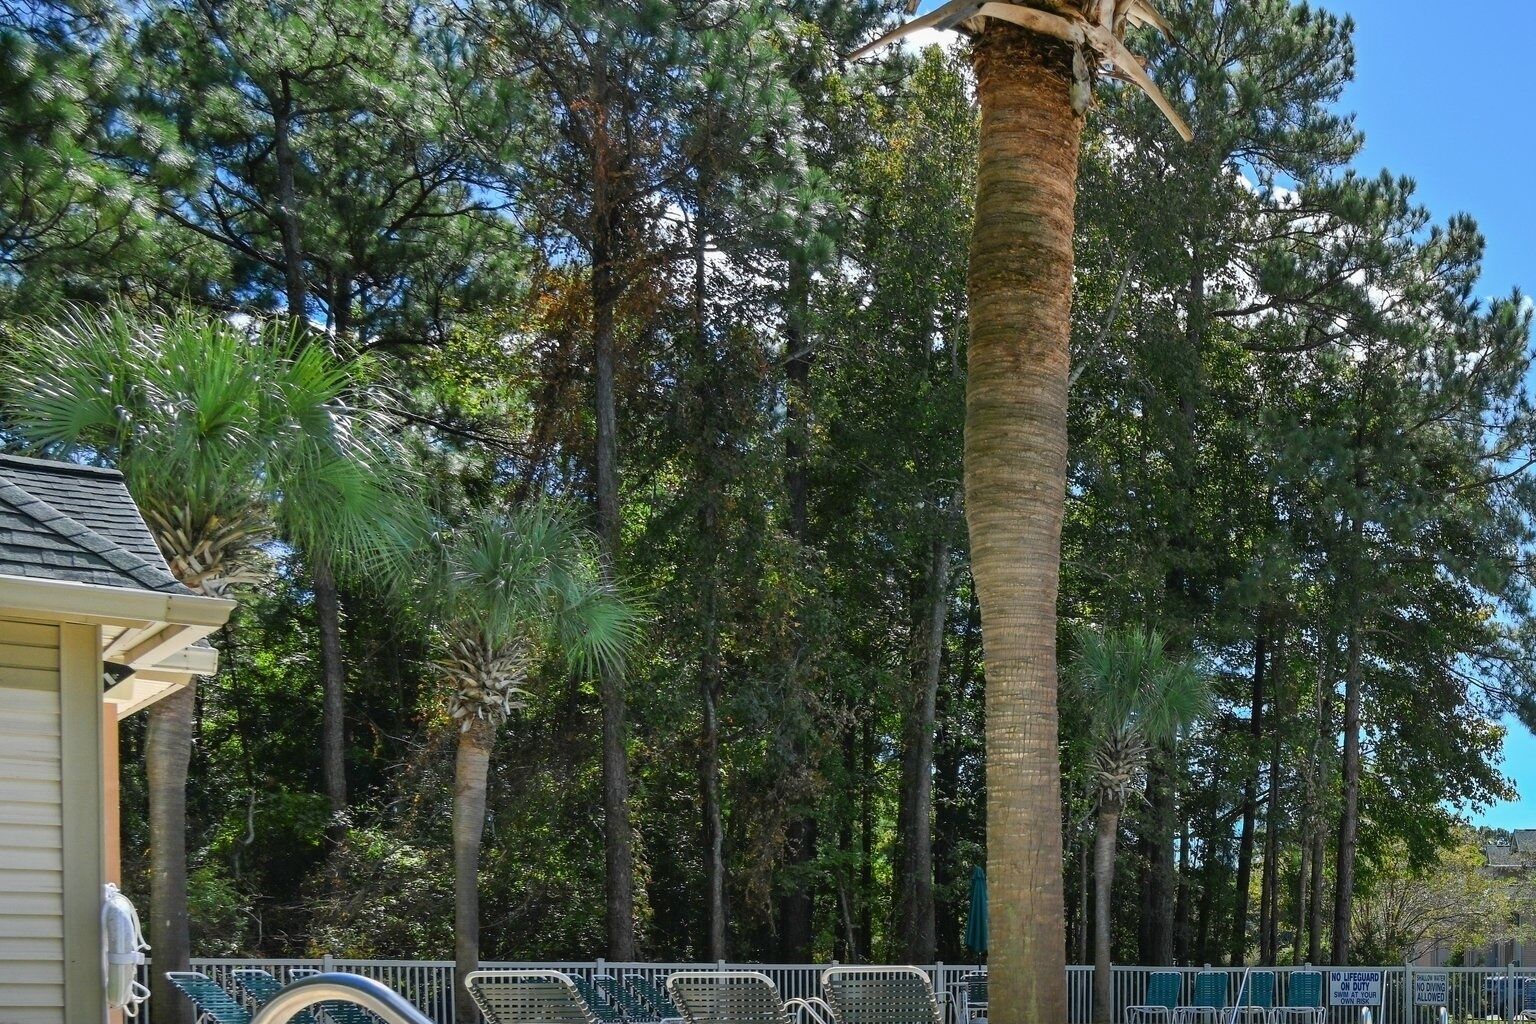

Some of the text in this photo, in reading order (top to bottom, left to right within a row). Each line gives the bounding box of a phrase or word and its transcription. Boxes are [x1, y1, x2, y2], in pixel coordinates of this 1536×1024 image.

[1331, 972, 1380, 982] NO LIFEGUARD
[1340, 982, 1370, 991] ON DUTY
[1416, 982, 1446, 992] NO DIVING
[1416, 992, 1445, 1002] ALLOWED
